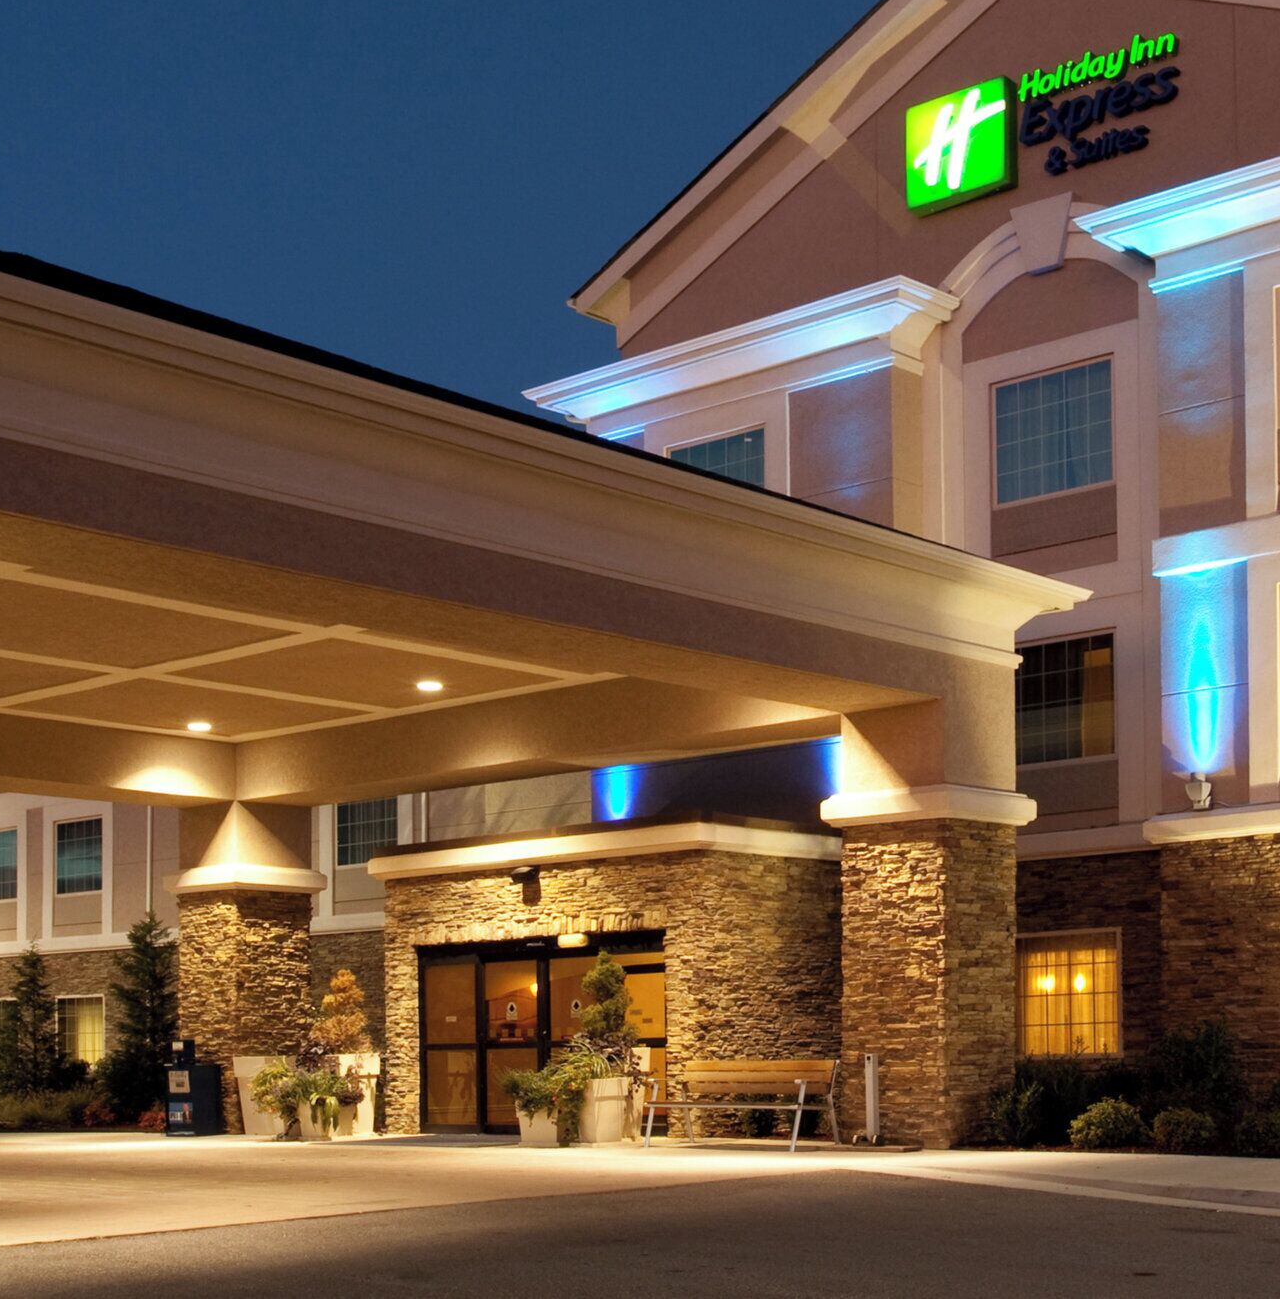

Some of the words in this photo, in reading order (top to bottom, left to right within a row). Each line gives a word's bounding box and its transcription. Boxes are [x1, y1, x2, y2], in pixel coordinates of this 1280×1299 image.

[1018, 47, 1125, 102] Holiday
[1128, 33, 1176, 66] Inn
[1020, 66, 1180, 147] Express
[1044, 146, 1068, 176] &
[1069, 125, 1150, 169] Suites
